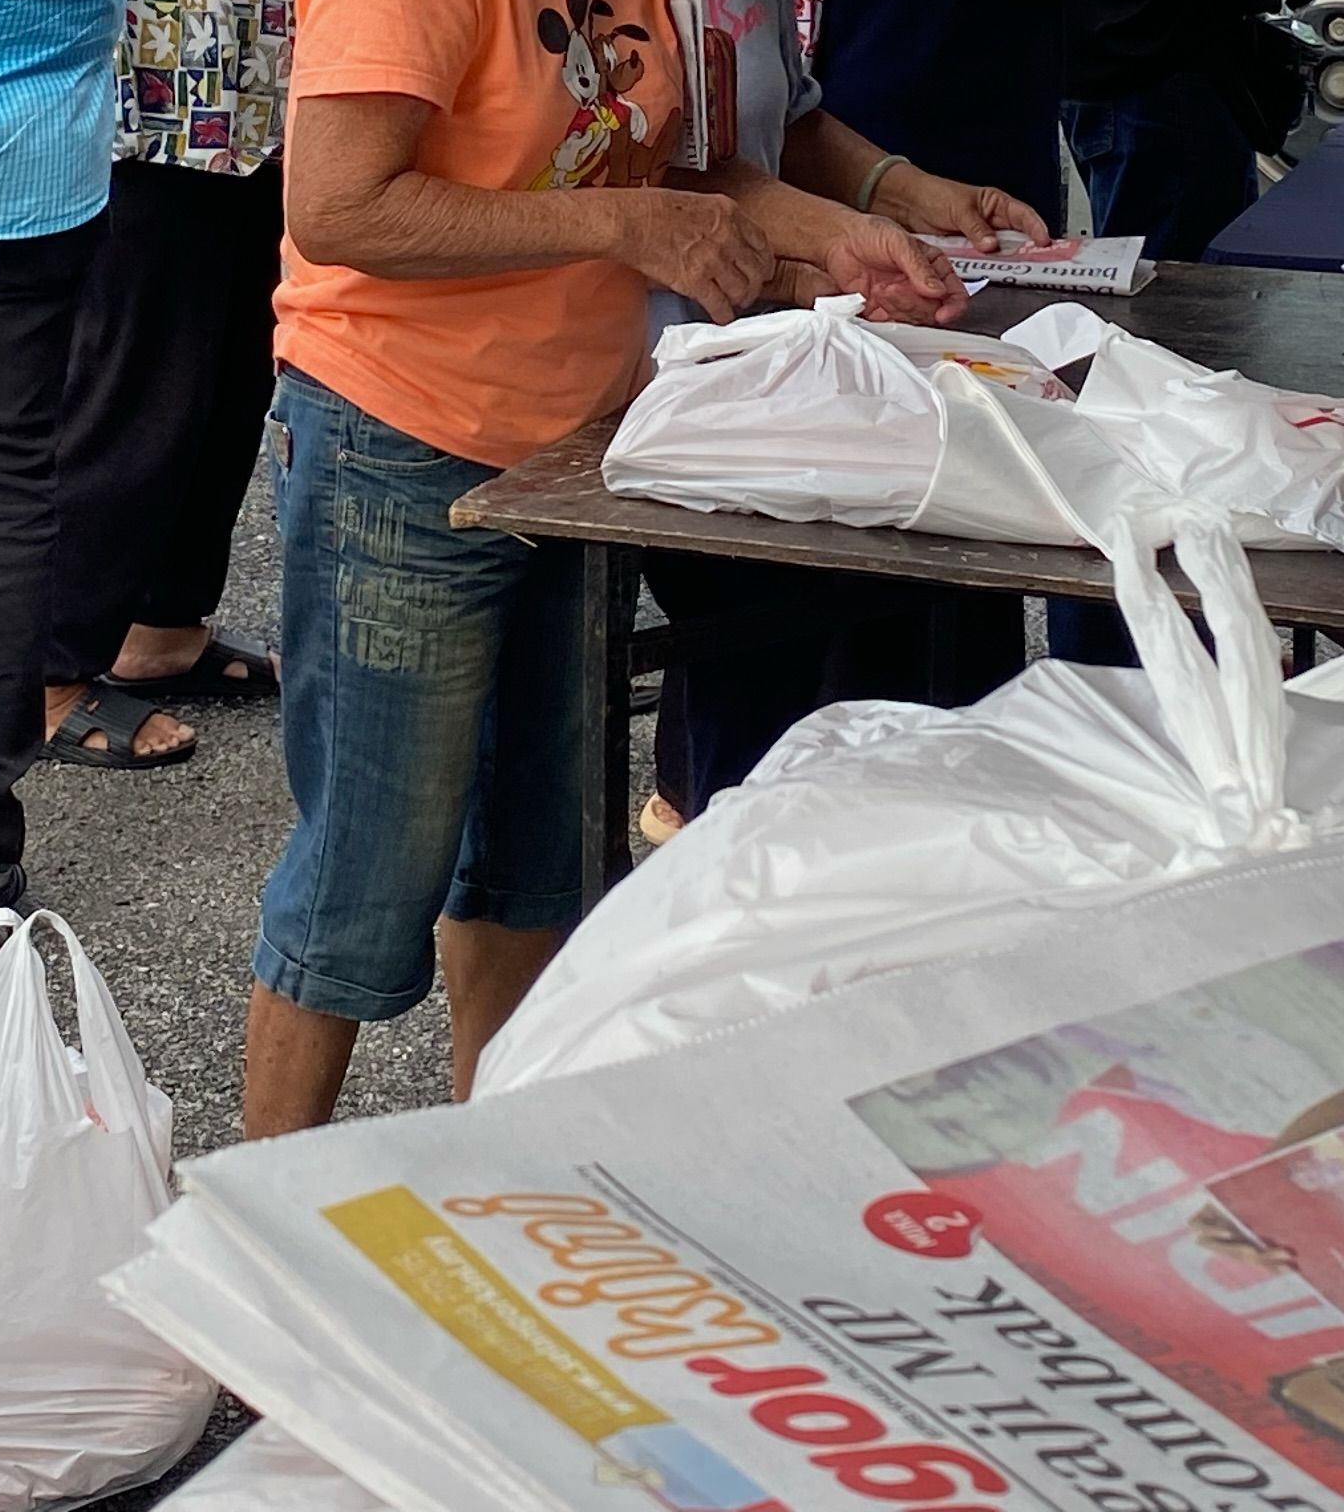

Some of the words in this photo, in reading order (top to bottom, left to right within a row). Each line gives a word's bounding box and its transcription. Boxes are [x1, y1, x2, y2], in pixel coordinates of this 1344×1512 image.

[1042, 266, 1119, 281] bantu
[920, 1207, 973, 1233] 2
[795, 1299, 995, 1397] MP
